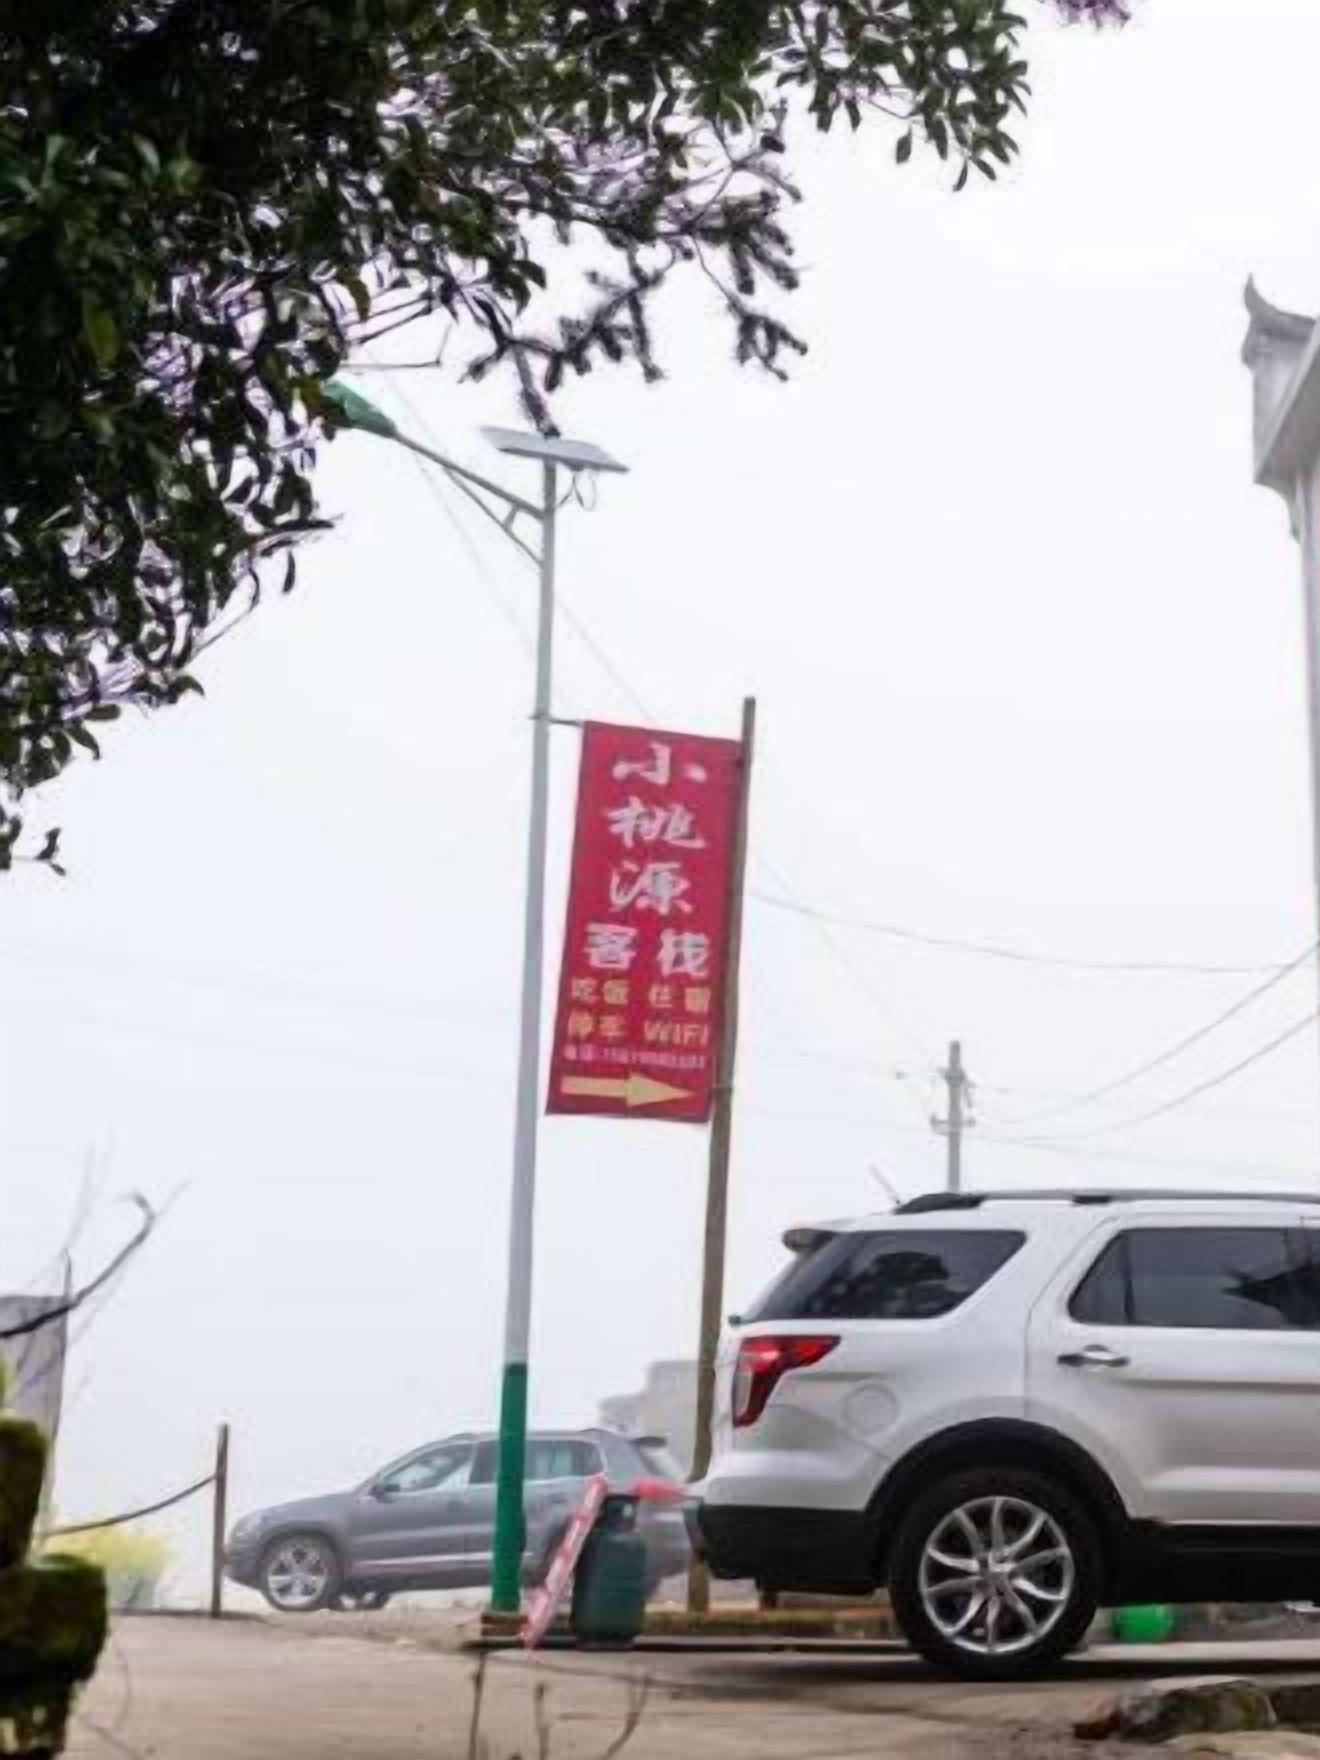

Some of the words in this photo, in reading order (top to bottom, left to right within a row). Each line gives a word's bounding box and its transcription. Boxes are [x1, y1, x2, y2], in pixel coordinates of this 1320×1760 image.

[608, 742, 707, 914] 小桃源
[585, 923, 710, 977] 客栈
